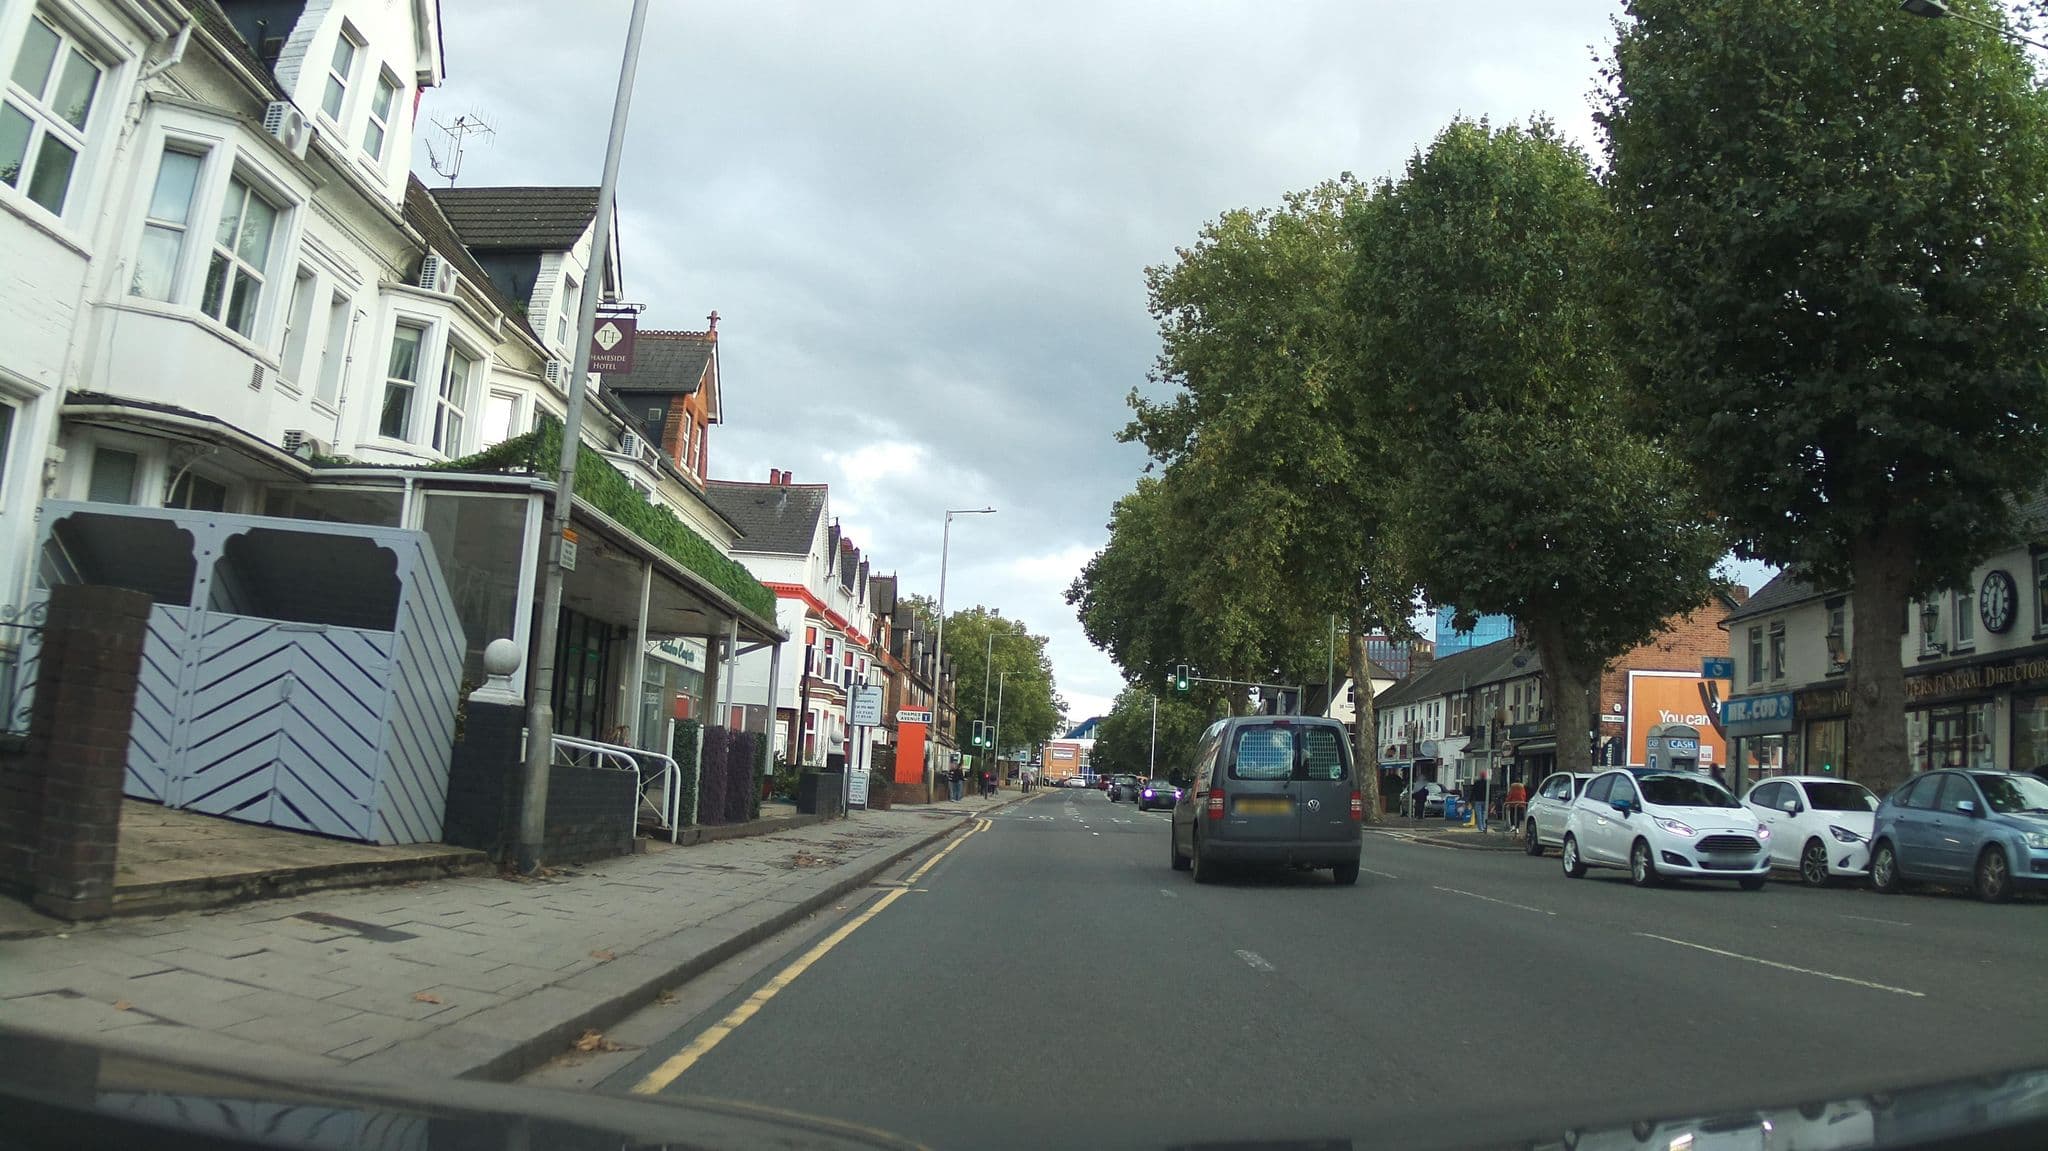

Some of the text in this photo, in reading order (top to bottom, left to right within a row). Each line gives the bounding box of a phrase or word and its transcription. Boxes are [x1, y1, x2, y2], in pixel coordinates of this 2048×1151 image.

[591, 354, 626, 362] HAMESIDE
[593, 362, 616, 370] HOTEL
[1936, 671, 1980, 695] FUNERAL
[1752, 697, 1778, 719] COD
[1659, 709, 1711, 726] You can
[1671, 740, 1695, 748] CASH
